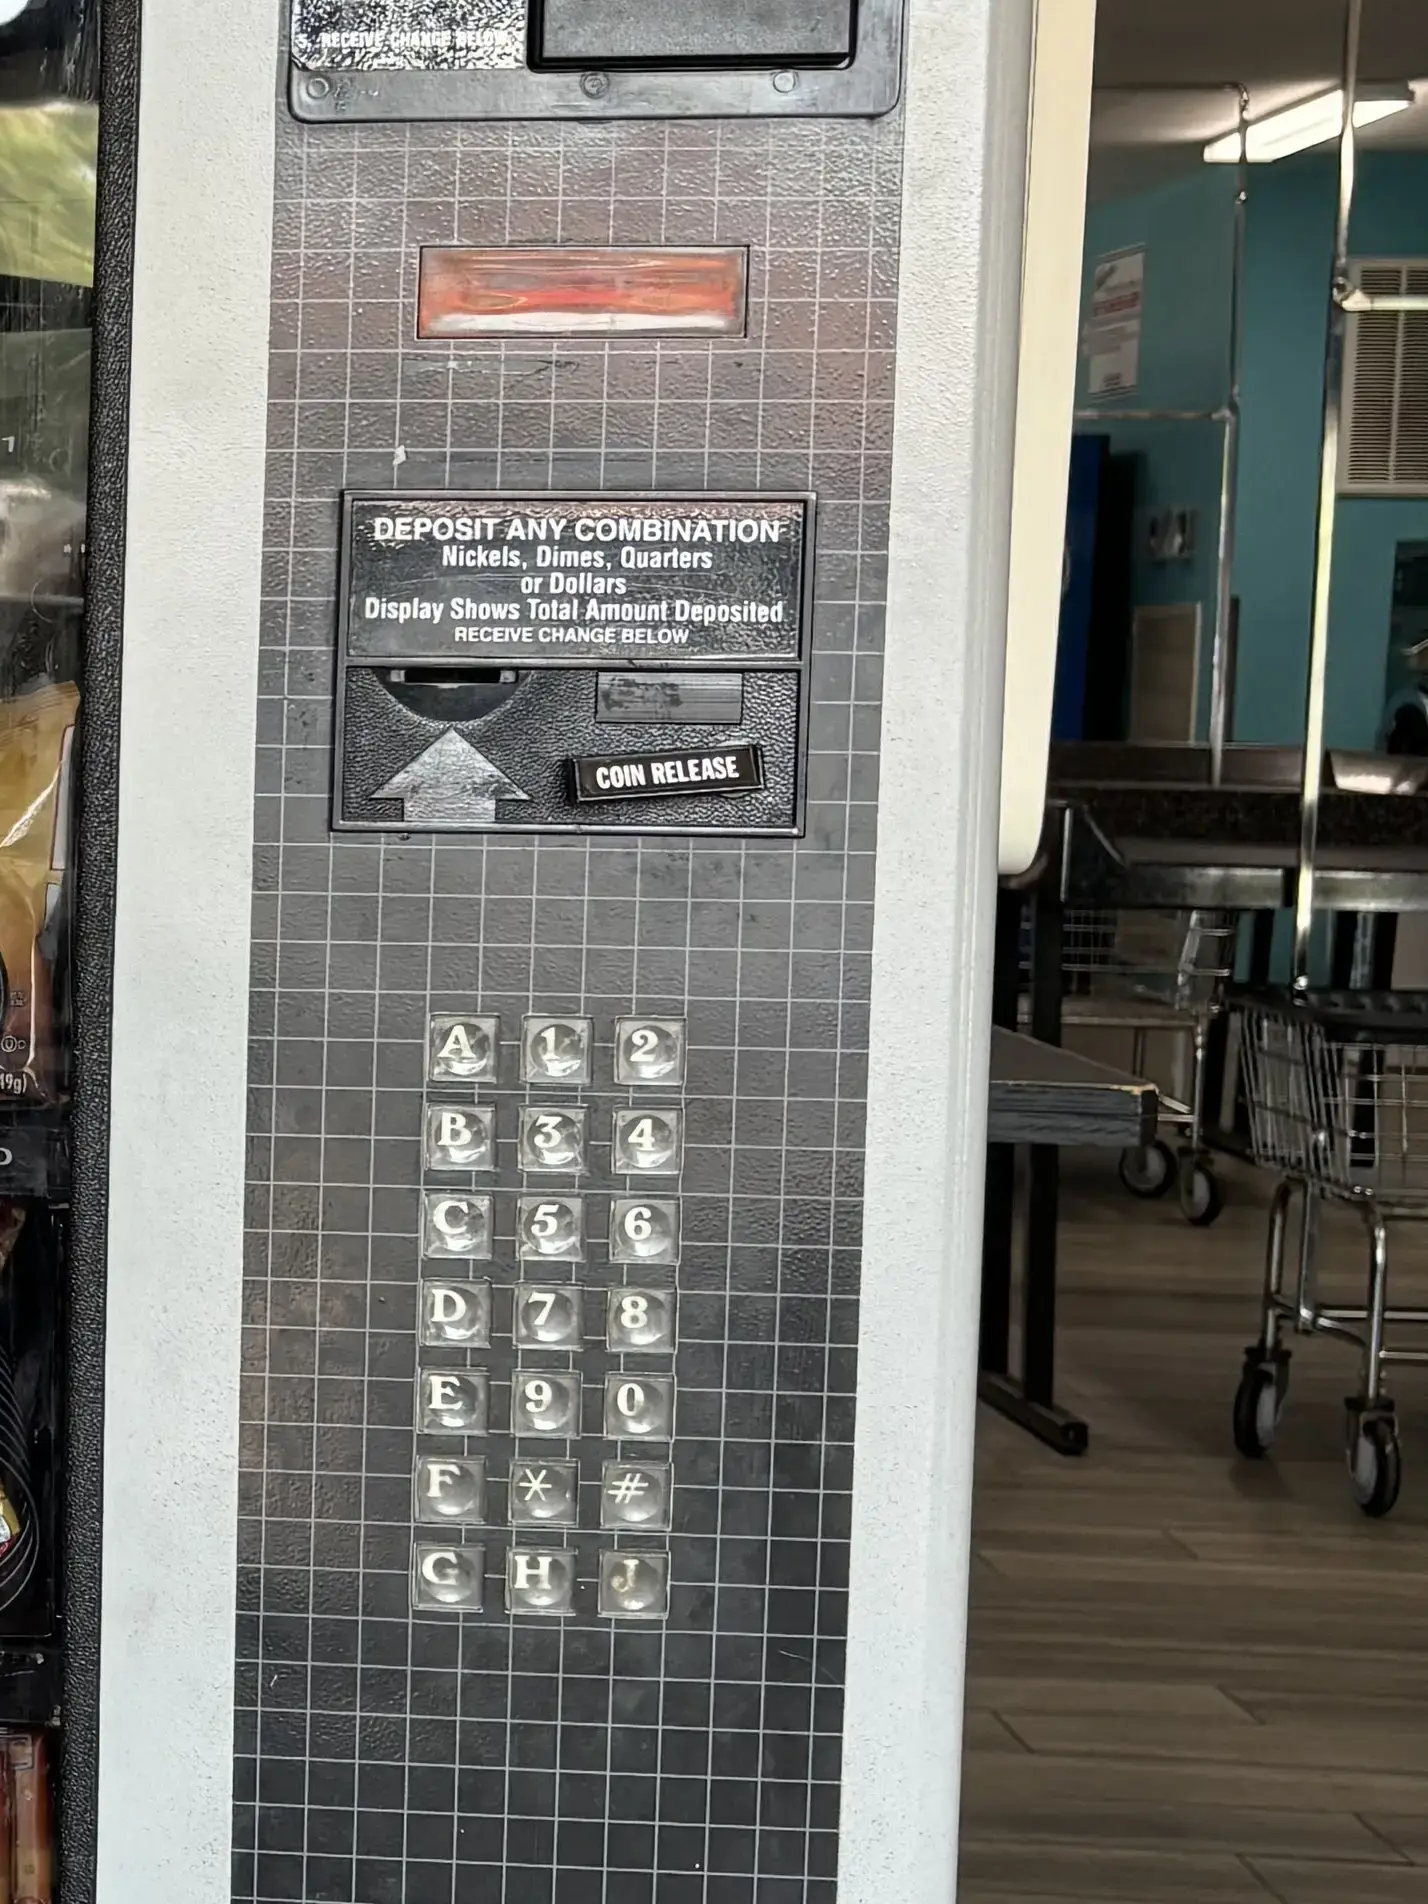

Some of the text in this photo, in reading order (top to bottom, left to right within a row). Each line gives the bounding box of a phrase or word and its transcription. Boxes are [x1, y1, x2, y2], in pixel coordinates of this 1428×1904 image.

[374, 518, 782, 544] DEPOSIT ANY COMBINATION
[442, 546, 713, 571] Nickels, Dimes, Quarters
[521, 572, 627, 595] or Dollars
[364, 597, 783, 626] Display Shows Total Amount Deposited
[454, 625, 690, 645] RECEIVE CHANGE BELOW
[595, 756, 739, 790] COIN RELEASE
[437, 1025, 476, 1060] A
[539, 1028, 558, 1061] 1
[630, 1028, 657, 1063] 2
[437, 1114, 473, 1147] B
[534, 1115, 562, 1148] 3
[627, 1118, 655, 1151] 4
